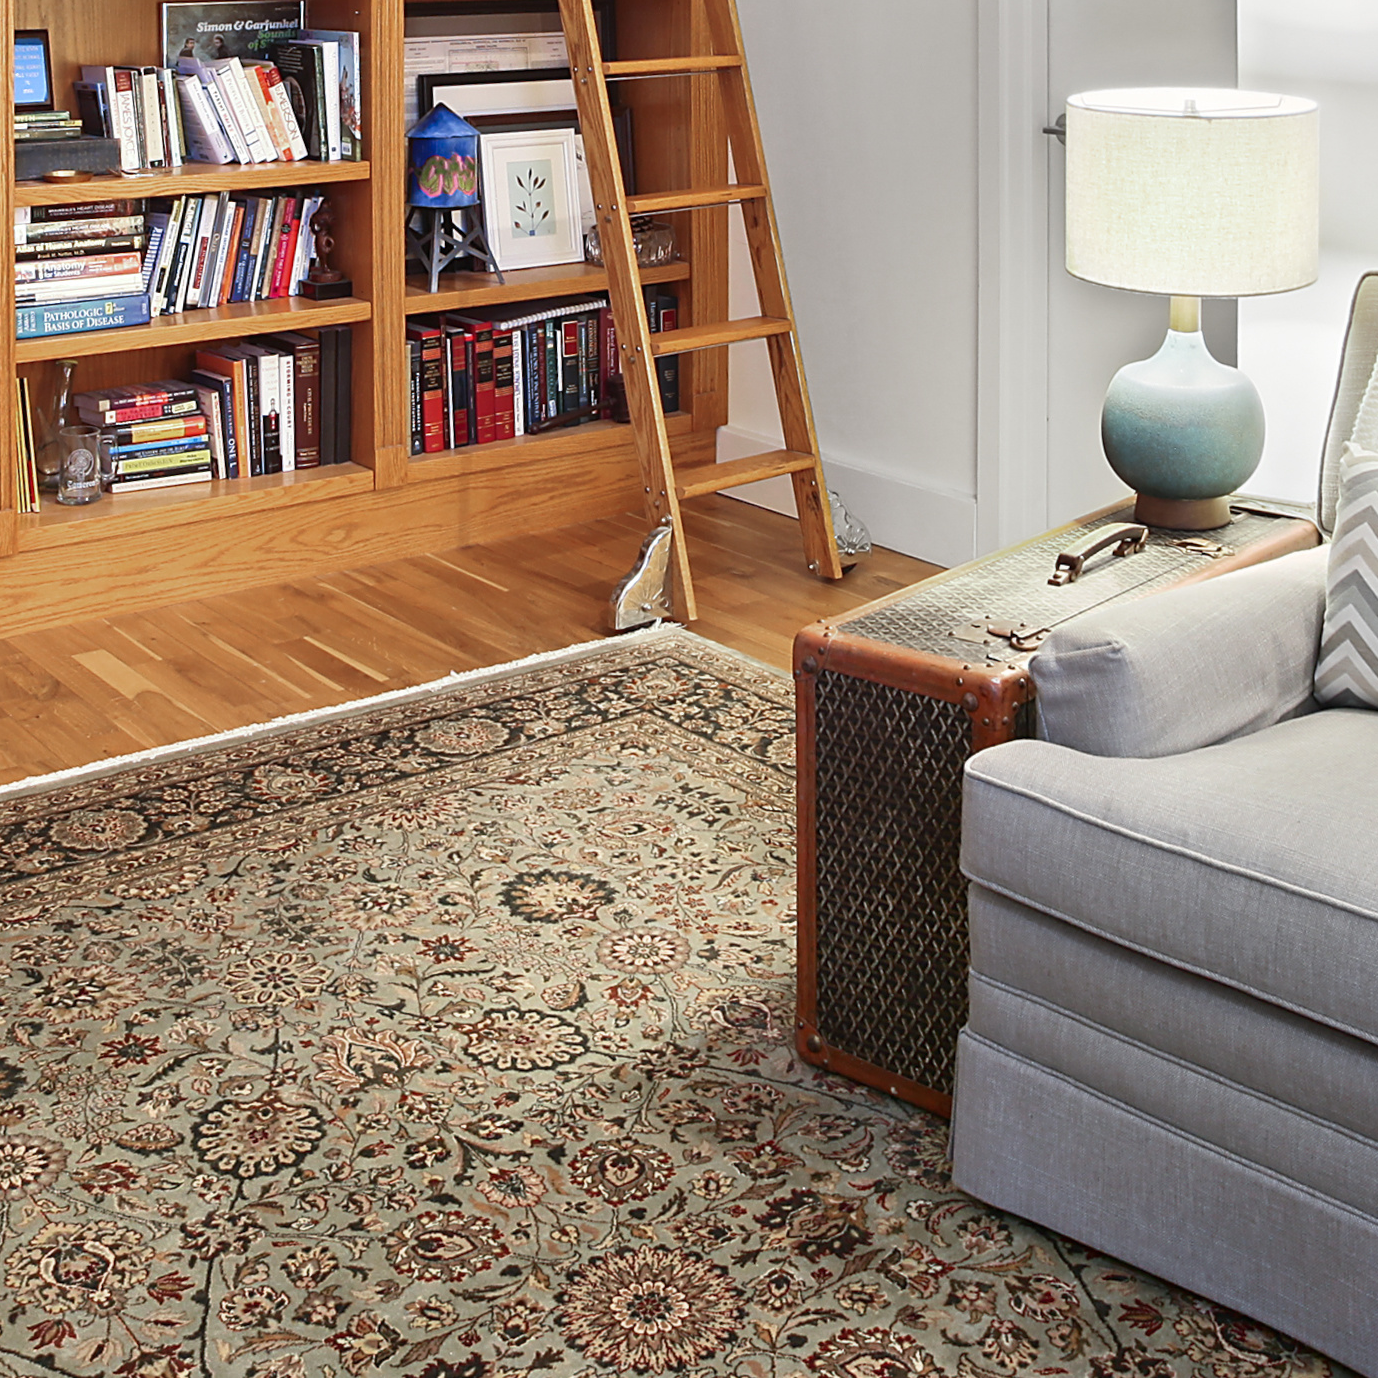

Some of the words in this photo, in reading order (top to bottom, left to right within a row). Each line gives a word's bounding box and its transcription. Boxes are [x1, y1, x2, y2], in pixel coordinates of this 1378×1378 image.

[196, 21, 232, 32] Simon
[234, 21, 244, 30] &
[245, 18, 298, 31] Garfunkel
[121, 94, 133, 123] JAMES
[274, 84, 300, 141] EMERSON
[124, 125, 135, 155] JOYCE
[45, 262, 85, 273] Anatomy
[44, 307, 102, 322] PATHOLOGIC
[45, 322, 70, 333] BASIS
[72, 320, 85, 329] OF
[87, 315, 125, 327] DISEASE
